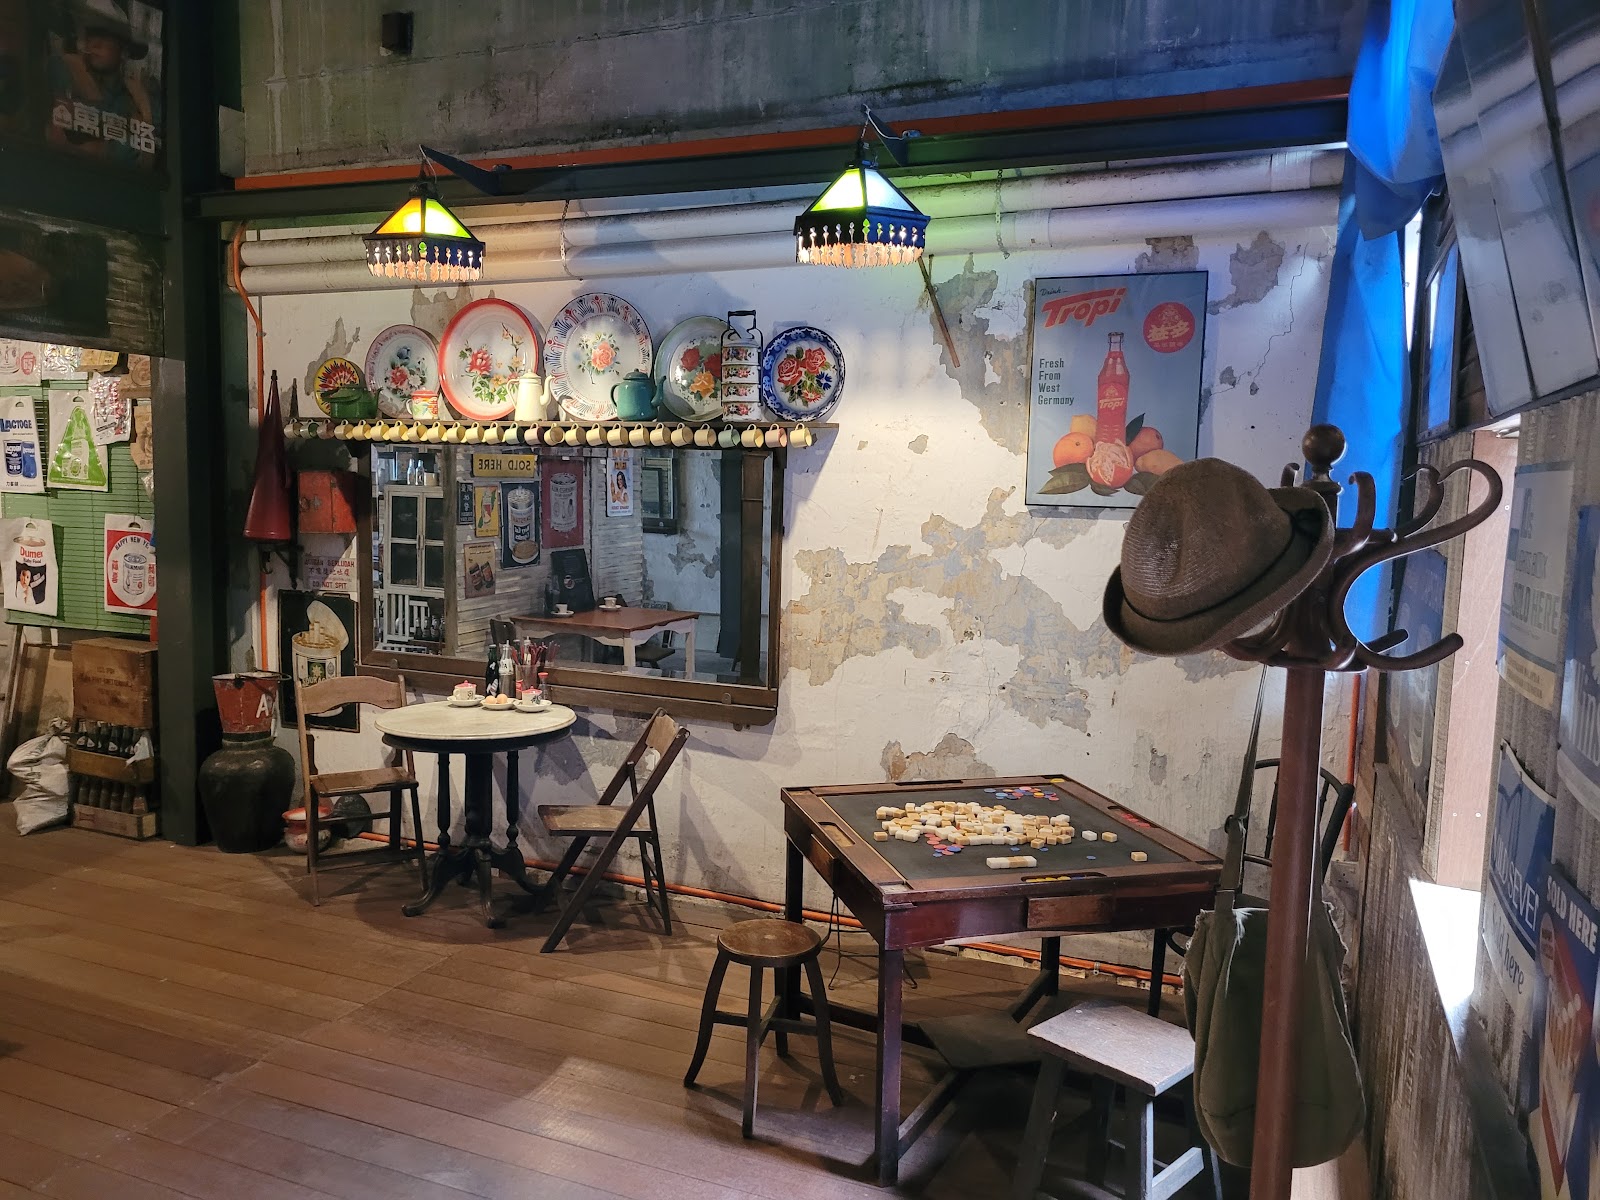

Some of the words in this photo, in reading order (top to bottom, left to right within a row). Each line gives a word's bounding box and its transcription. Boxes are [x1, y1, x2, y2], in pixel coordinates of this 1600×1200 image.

[1039, 286, 1061, 296] Drink
[1041, 288, 1127, 328] Tropi
[1039, 358, 1065, 368] Fresh
[1038, 371, 1061, 381] From
[1038, 383, 1061, 393] West
[1037, 395, 1075, 406] Germany
[1099, 397, 1124, 410] Tropi
[115, 537, 128, 550] HAPPY
[1530, 588, 1560, 635] HERE
[1546, 875, 1567, 919] SOLD
[1568, 899, 1598, 954] HERE
[1503, 932, 1524, 994] here
